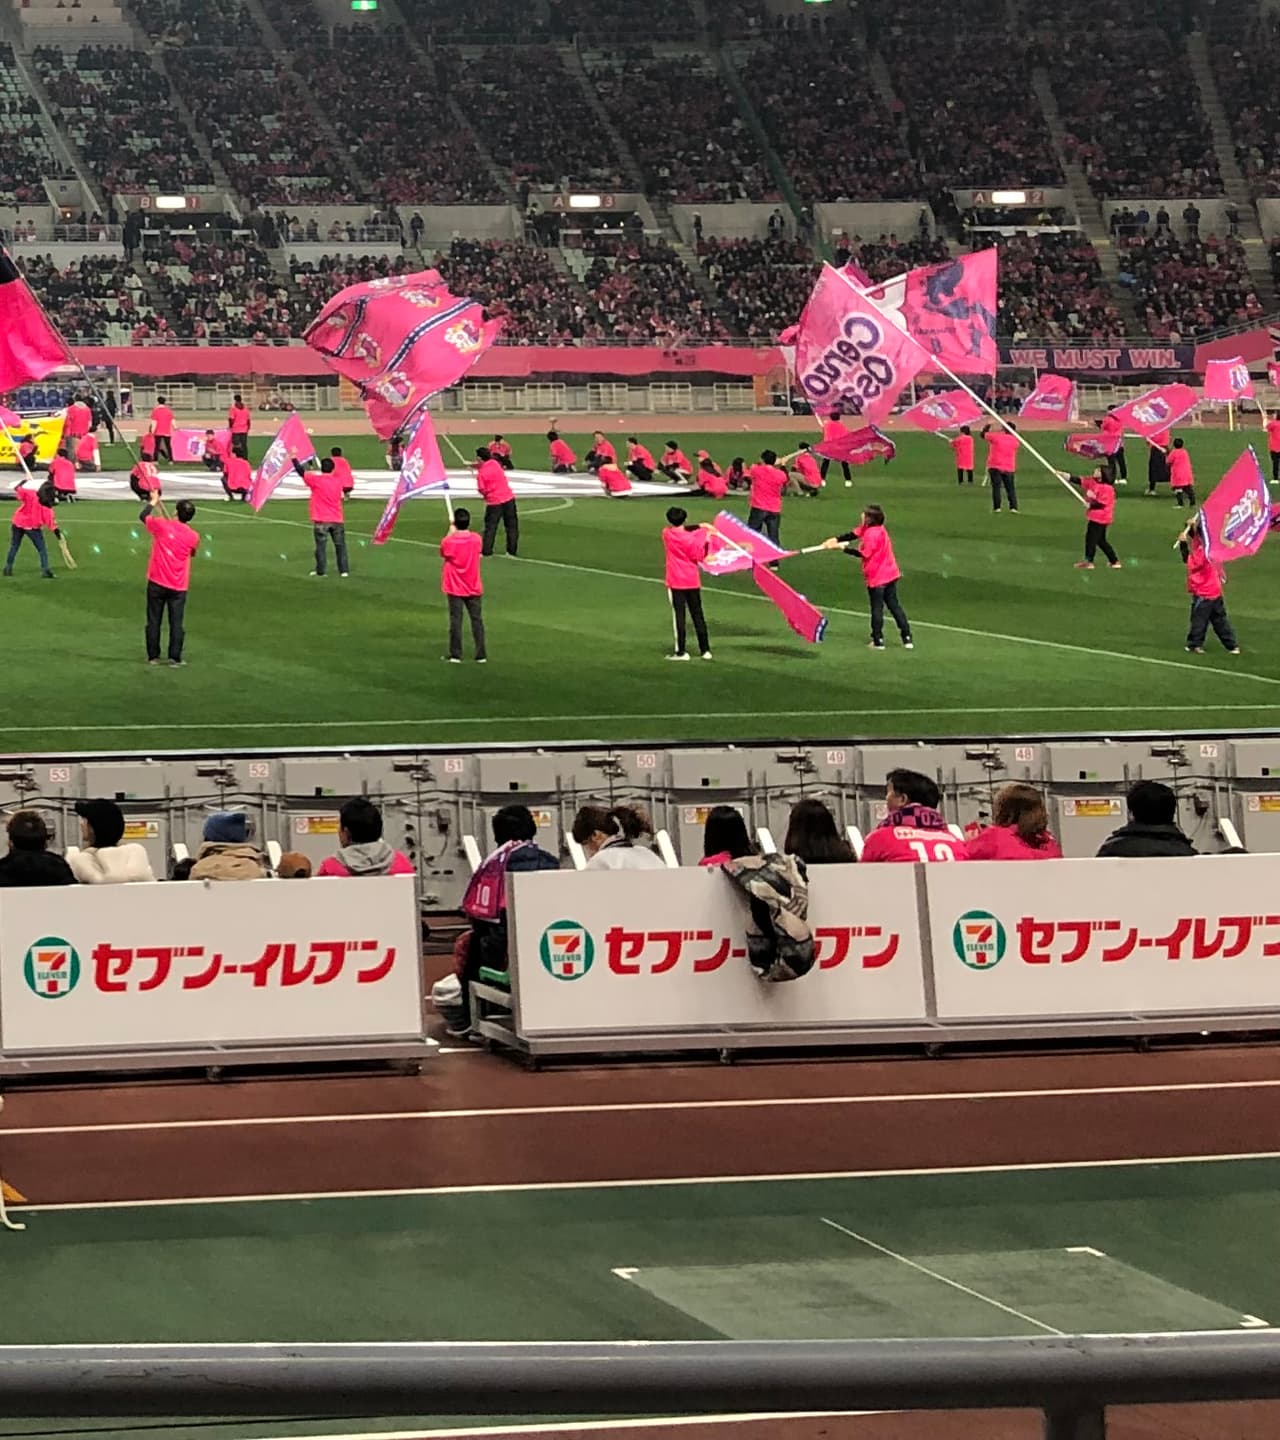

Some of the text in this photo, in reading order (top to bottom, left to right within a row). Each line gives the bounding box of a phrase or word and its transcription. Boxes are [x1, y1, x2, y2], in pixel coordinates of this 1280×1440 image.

[554, 196, 613, 206] A 3
[975, 192, 1042, 203] A 2
[1010, 349, 1181, 368] WE MUST WIN.
[1016, 748, 1033, 759] 48
[1201, 745, 1217, 756] 47
[638, 755, 654, 767] 50
[827, 752, 844, 764] 49
[250, 764, 267, 776] 52
[445, 760, 462, 772] 51
[51, 768, 68, 781] 53
[476, 883, 490, 907] 10
